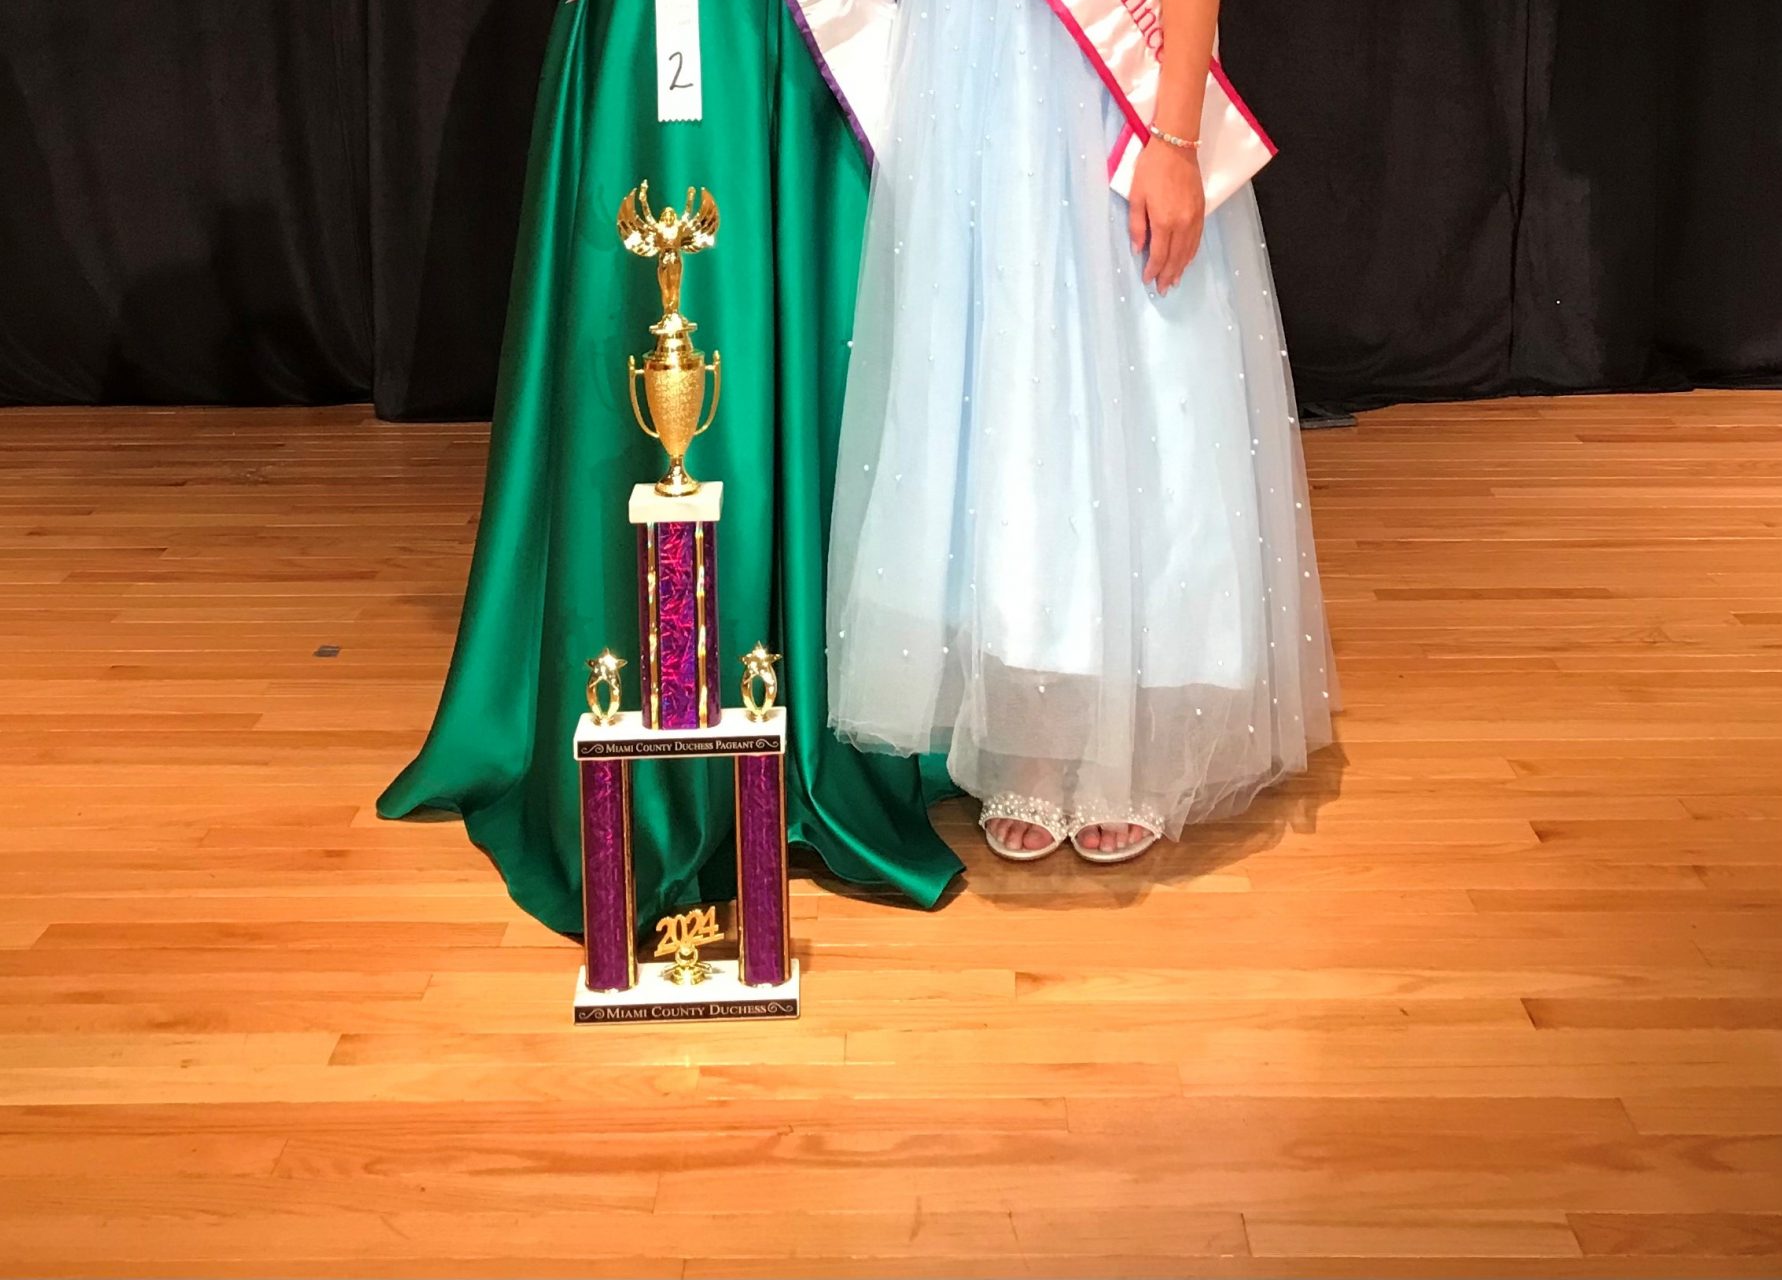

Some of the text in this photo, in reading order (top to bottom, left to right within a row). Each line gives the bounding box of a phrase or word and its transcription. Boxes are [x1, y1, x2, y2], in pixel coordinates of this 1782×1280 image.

[668, 51, 694, 91] 2
[606, 739, 754, 753] MIAMI COUNTY DUCHESS PAGEANT
[655, 906, 720, 950] 2024
[606, 1003, 767, 1019] MIAMI COUNTY DUCHESS
